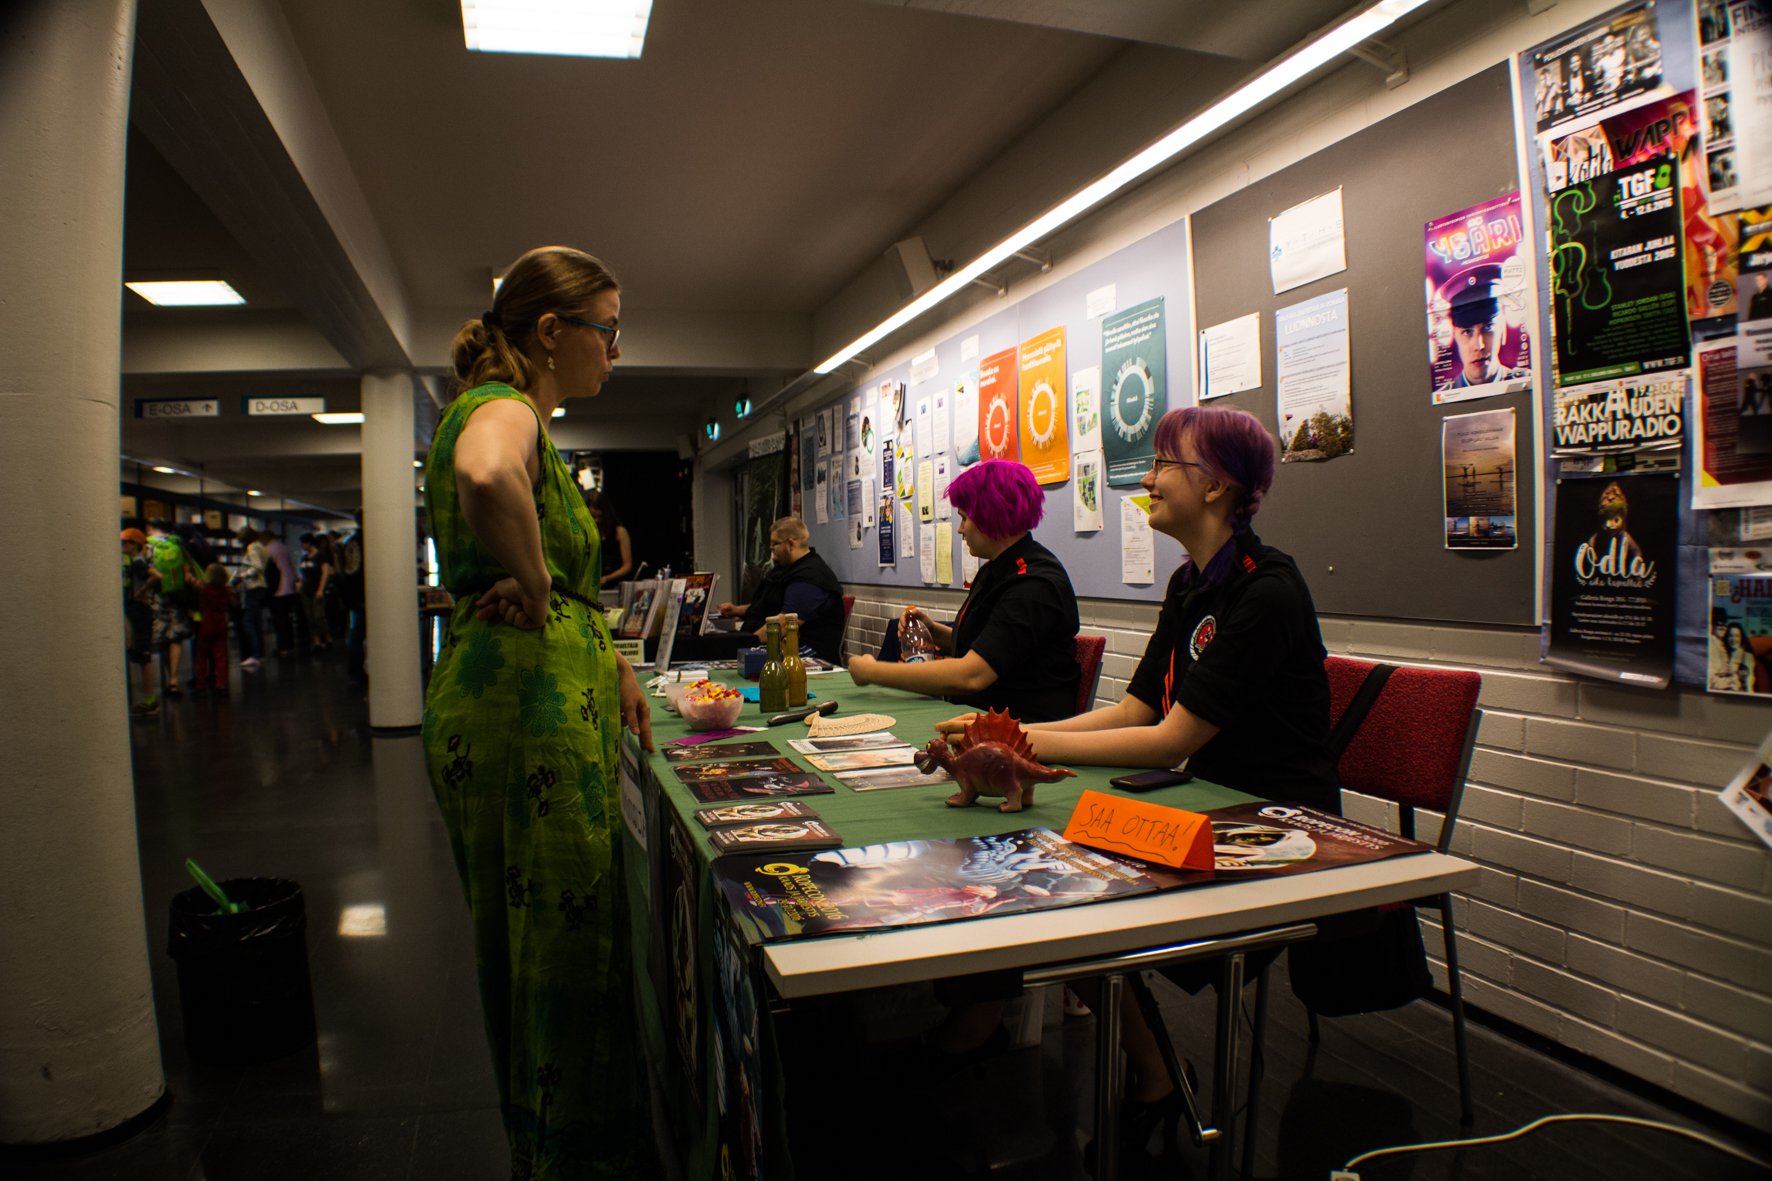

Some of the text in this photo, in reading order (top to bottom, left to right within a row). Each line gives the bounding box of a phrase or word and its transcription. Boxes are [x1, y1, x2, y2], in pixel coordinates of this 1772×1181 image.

[149, 403, 191, 416] E-OSA
[255, 400, 298, 412] D-OSA
[1556, 388, 1681, 426] RAKKAUDEN
[1556, 414, 1682, 446] WAPPURADIO
[1574, 535, 1655, 579] Odla
[1079, 803, 1197, 852] SAA OTTAA!
